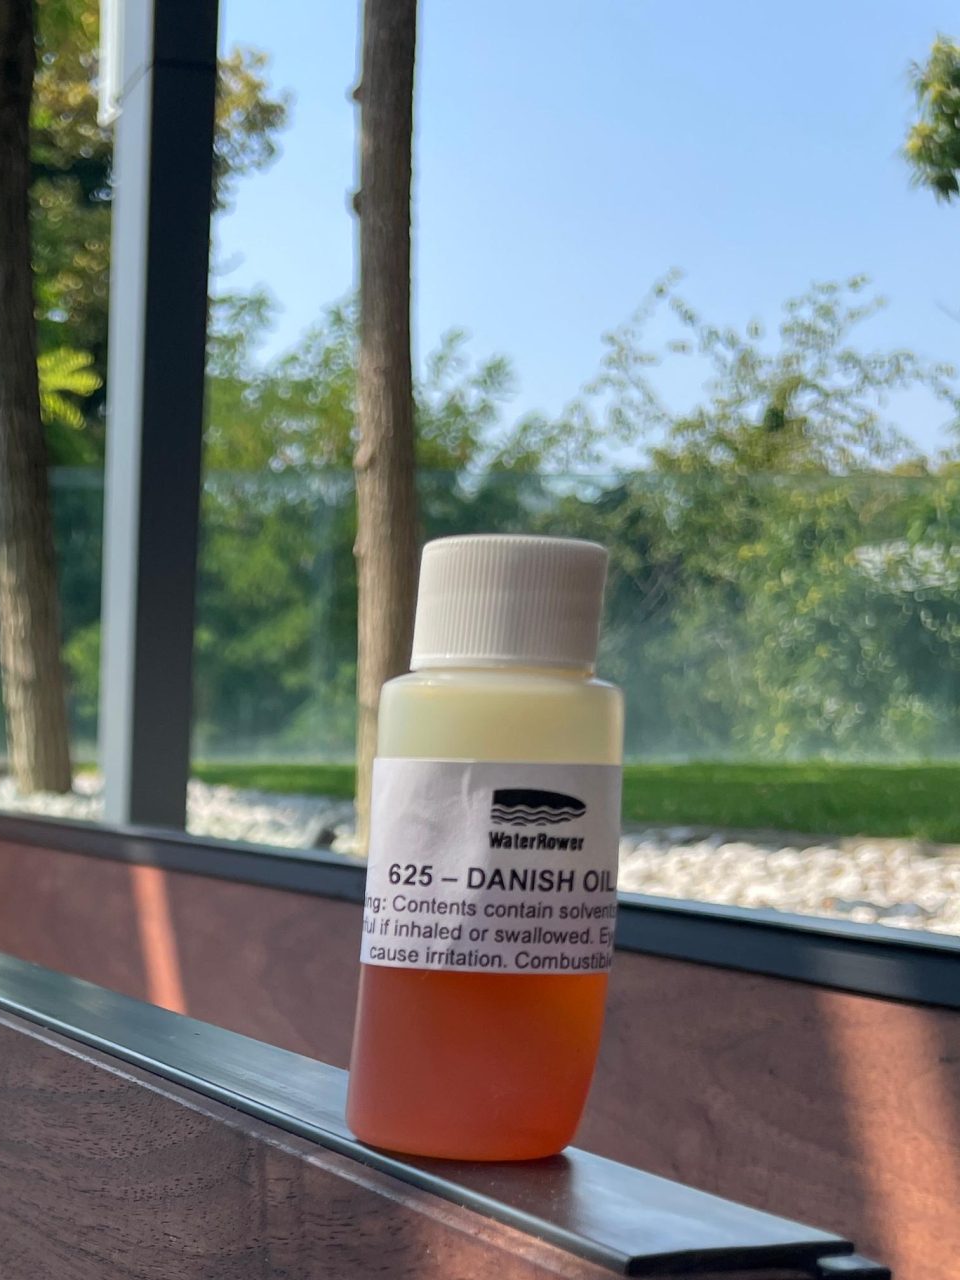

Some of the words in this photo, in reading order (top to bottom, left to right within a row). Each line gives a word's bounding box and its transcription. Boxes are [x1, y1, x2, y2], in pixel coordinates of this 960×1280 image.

[489, 832, 584, 851] WaterRower
[389, 863, 433, 886] 625
[466, 867, 575, 892] DANISH
[583, 869, 615, 892] OIL
[393, 894, 476, 917] Contents
[484, 899, 553, 919] contain
[380, 919, 390, 936] if
[394, 919, 462, 941] inhaled
[469, 928, 488, 942] or
[494, 926, 593, 945] swallowed.
[370, 945, 419, 963] cause
[426, 946, 507, 969] irritation.
